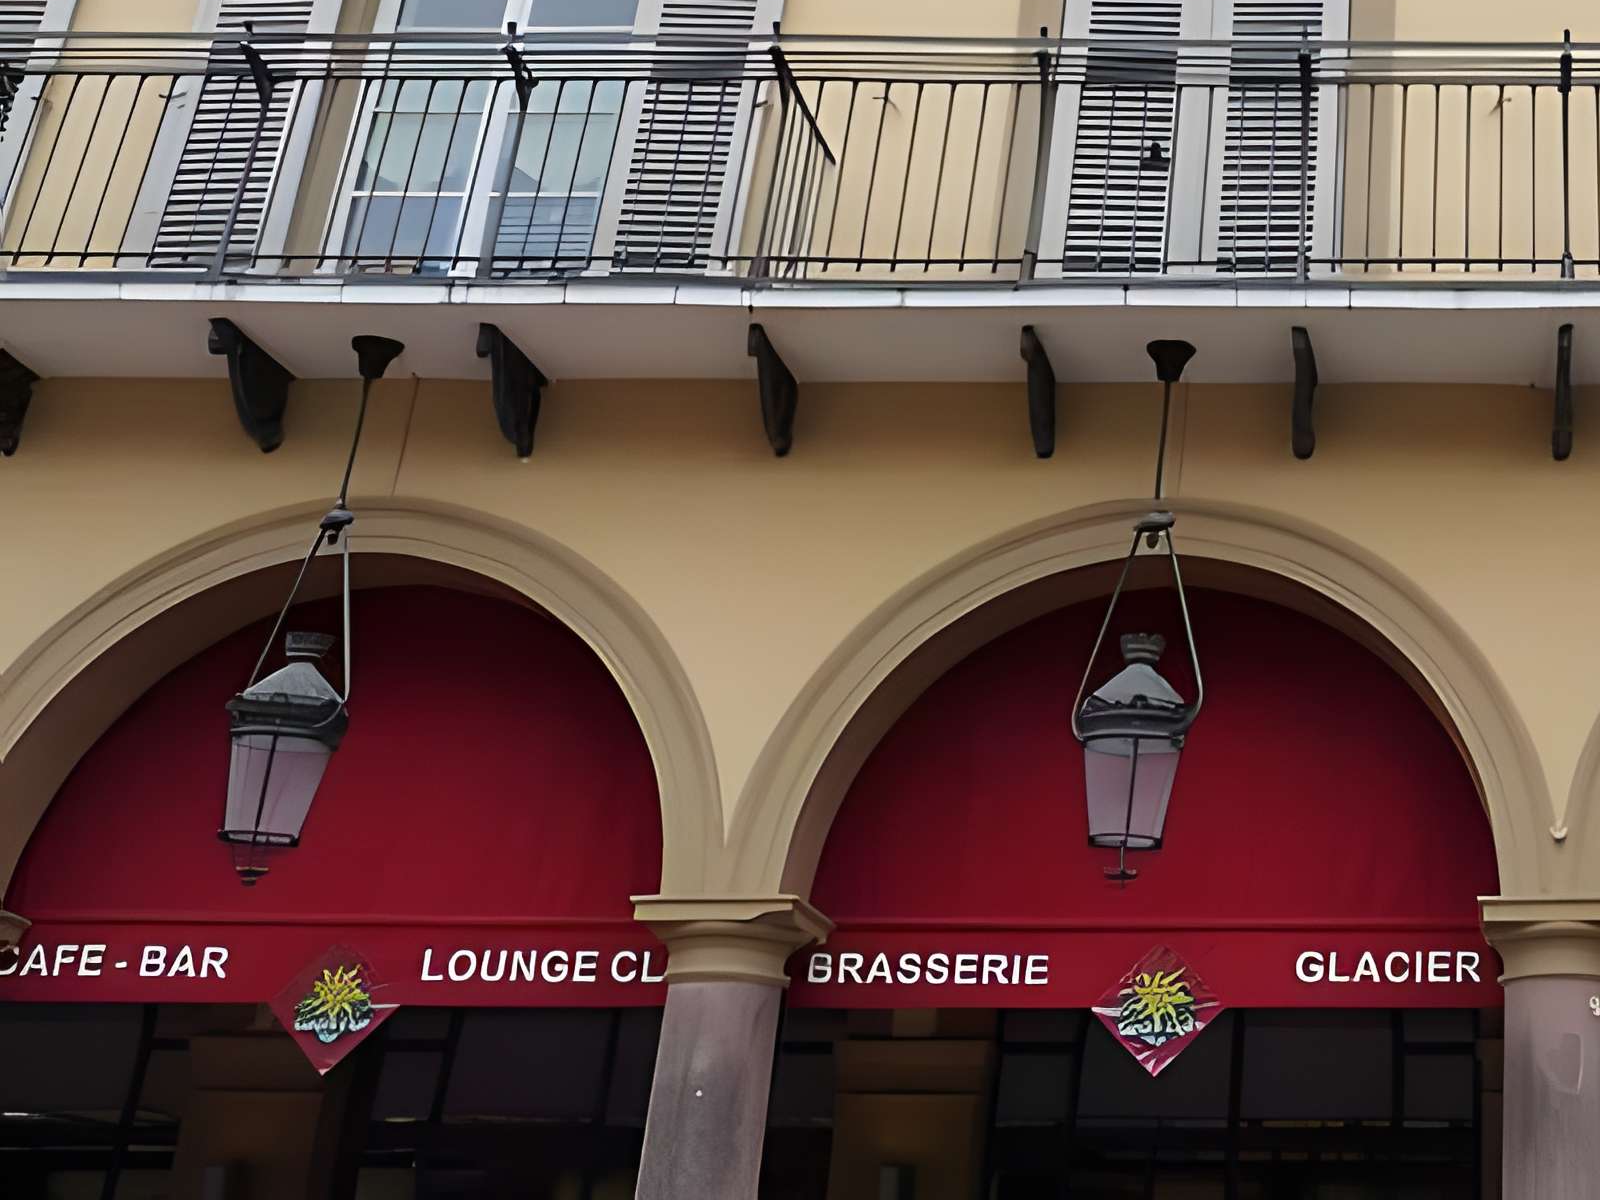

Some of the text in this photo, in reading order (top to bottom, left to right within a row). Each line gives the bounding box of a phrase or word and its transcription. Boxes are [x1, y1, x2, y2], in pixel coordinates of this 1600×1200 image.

[139, 944, 229, 979] BAR
[420, 948, 600, 983] LOUNGE
[807, 952, 1049, 985] BRASSERIE
[1295, 950, 1481, 983] GLACIER
